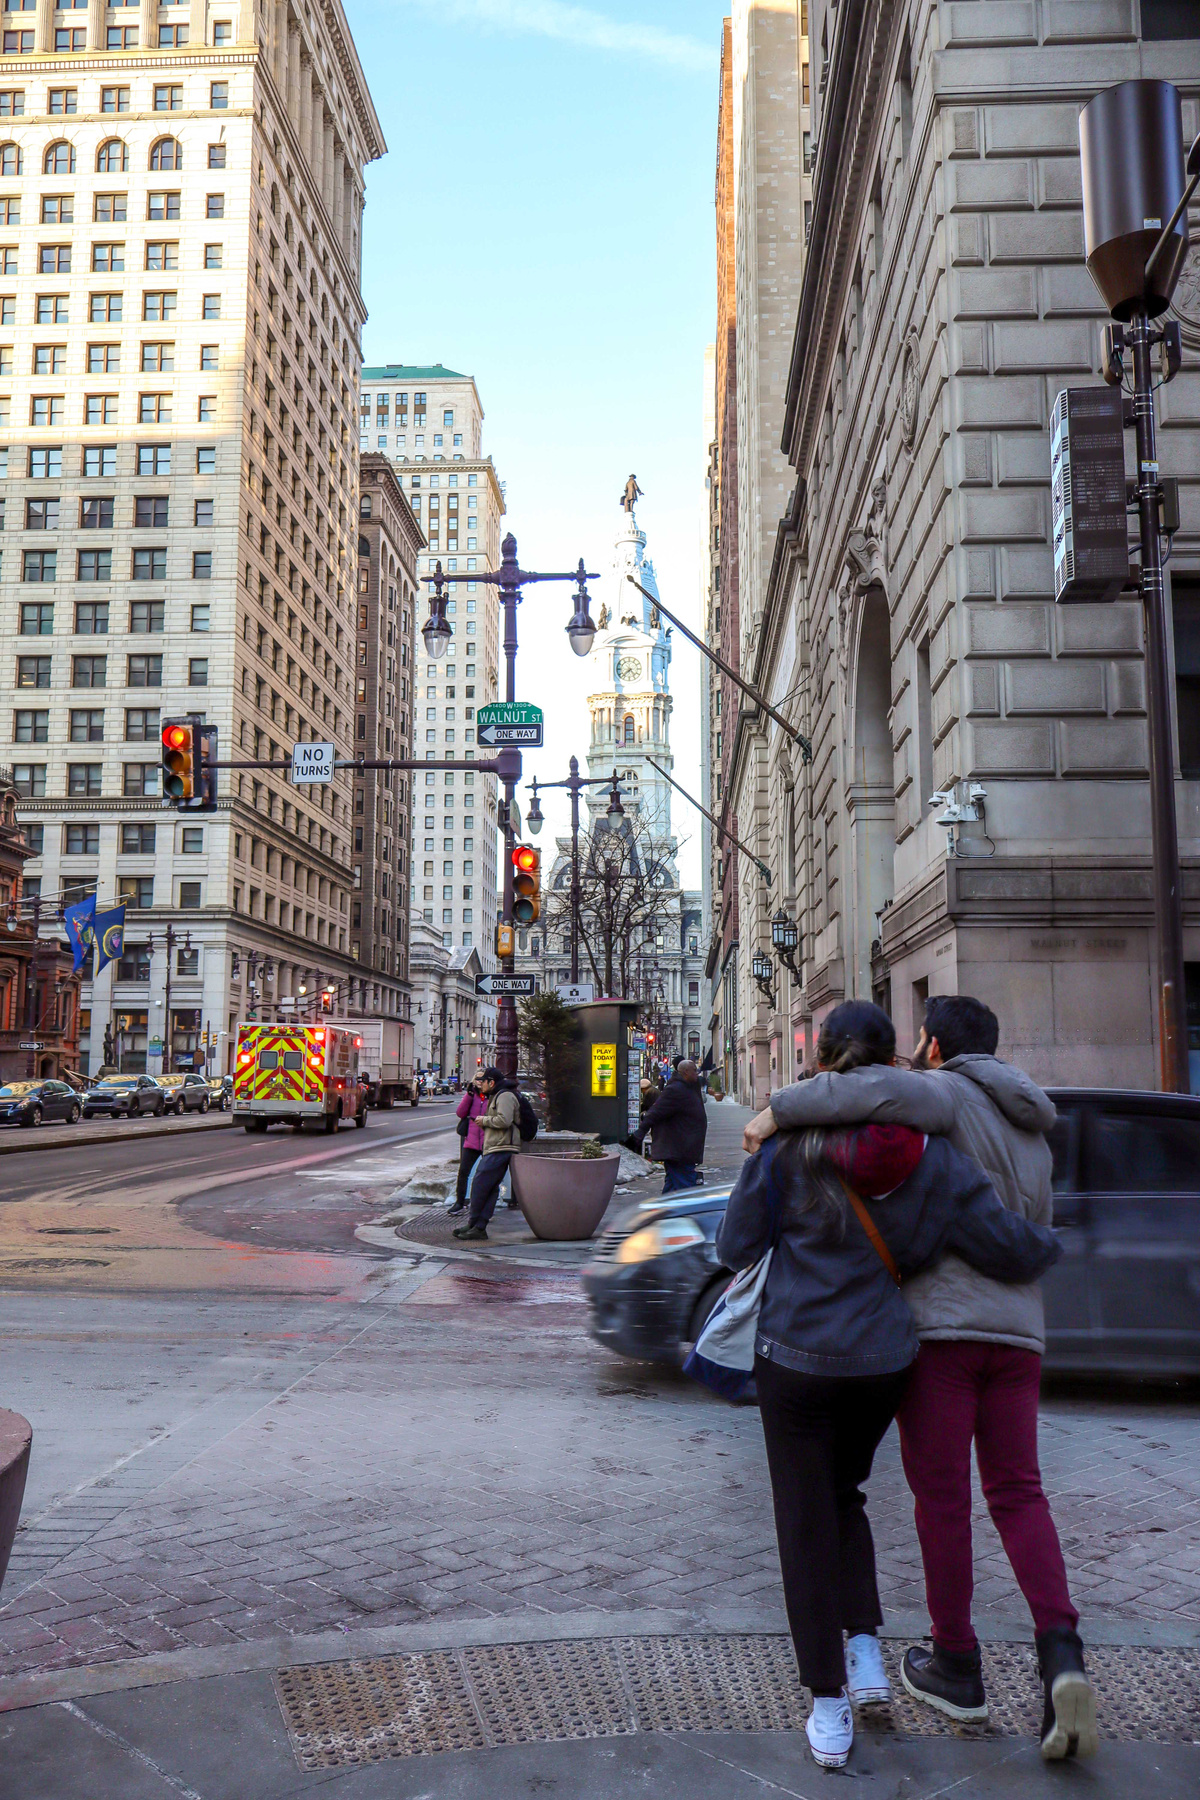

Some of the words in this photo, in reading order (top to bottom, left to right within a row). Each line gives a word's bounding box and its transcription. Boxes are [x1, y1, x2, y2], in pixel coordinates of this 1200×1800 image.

[480, 711, 527, 723] WALNUT
[531, 714, 541, 722] ST
[496, 730, 513, 738] ONE
[516, 729, 534, 738] WAY
[303, 749, 324, 761] NO
[295, 765, 330, 776] TURNS
[1030, 939, 1076, 948] WALNUT
[492, 980, 509, 989] ONE
[510, 980, 529, 989] WAY
